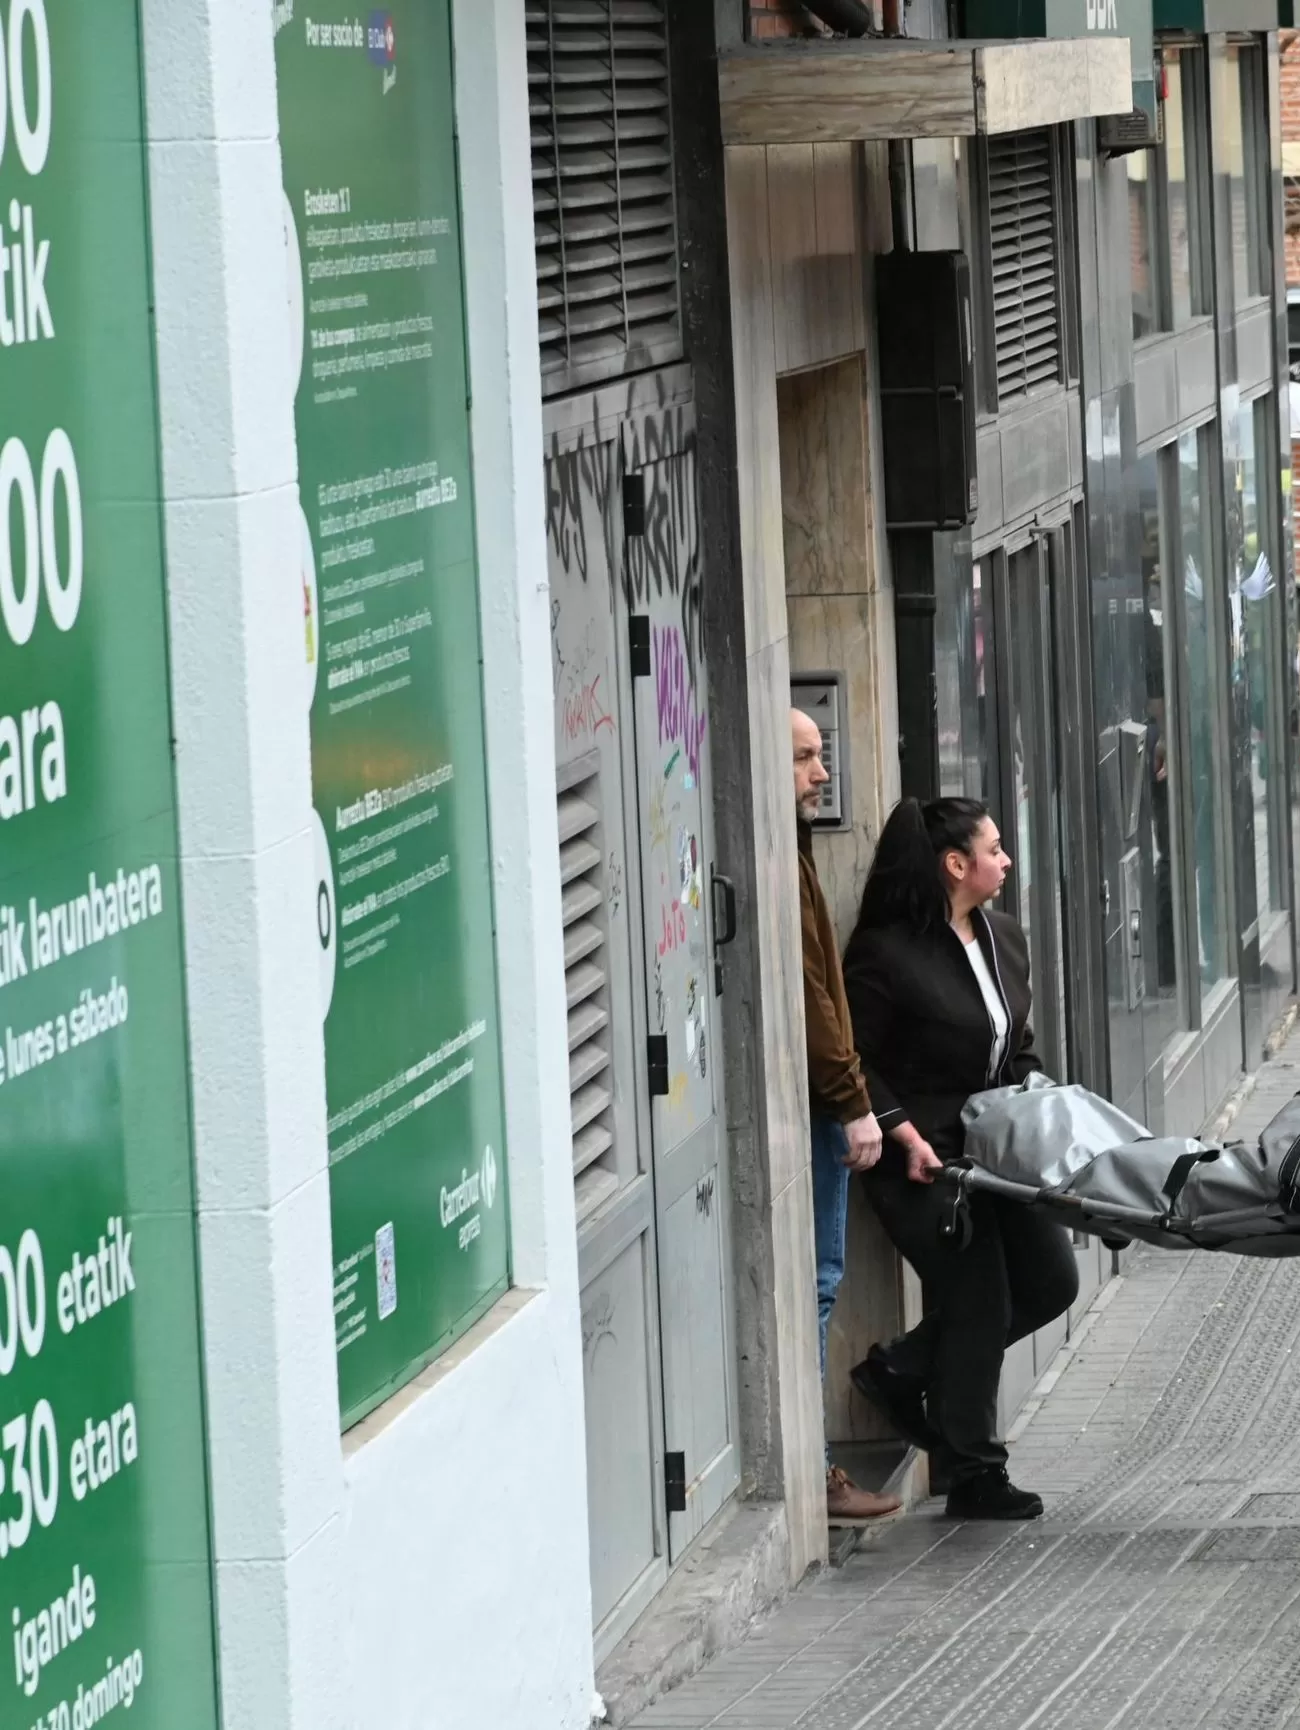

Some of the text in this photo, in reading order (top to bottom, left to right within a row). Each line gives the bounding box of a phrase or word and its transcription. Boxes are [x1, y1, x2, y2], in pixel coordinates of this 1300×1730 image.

[305, 17, 320, 47] Por
[320, 23, 332, 46] ser
[333, 16, 353, 46] socio
[354, 17, 363, 47] de
[29, 863, 163, 971] larunbatera
[6, 1026, 54, 1080] lunes
[56, 1014, 68, 1055] a
[69, 976, 128, 1047] sábado
[440, 1167, 480, 1229] Carrefour
[459, 1213, 481, 1252] express
[57, 1216, 136, 1335] etatik
[70, 1401, 138, 1501] etara
[12, 1564, 96, 1698] igande
[72, 1648, 143, 1730] domingo
